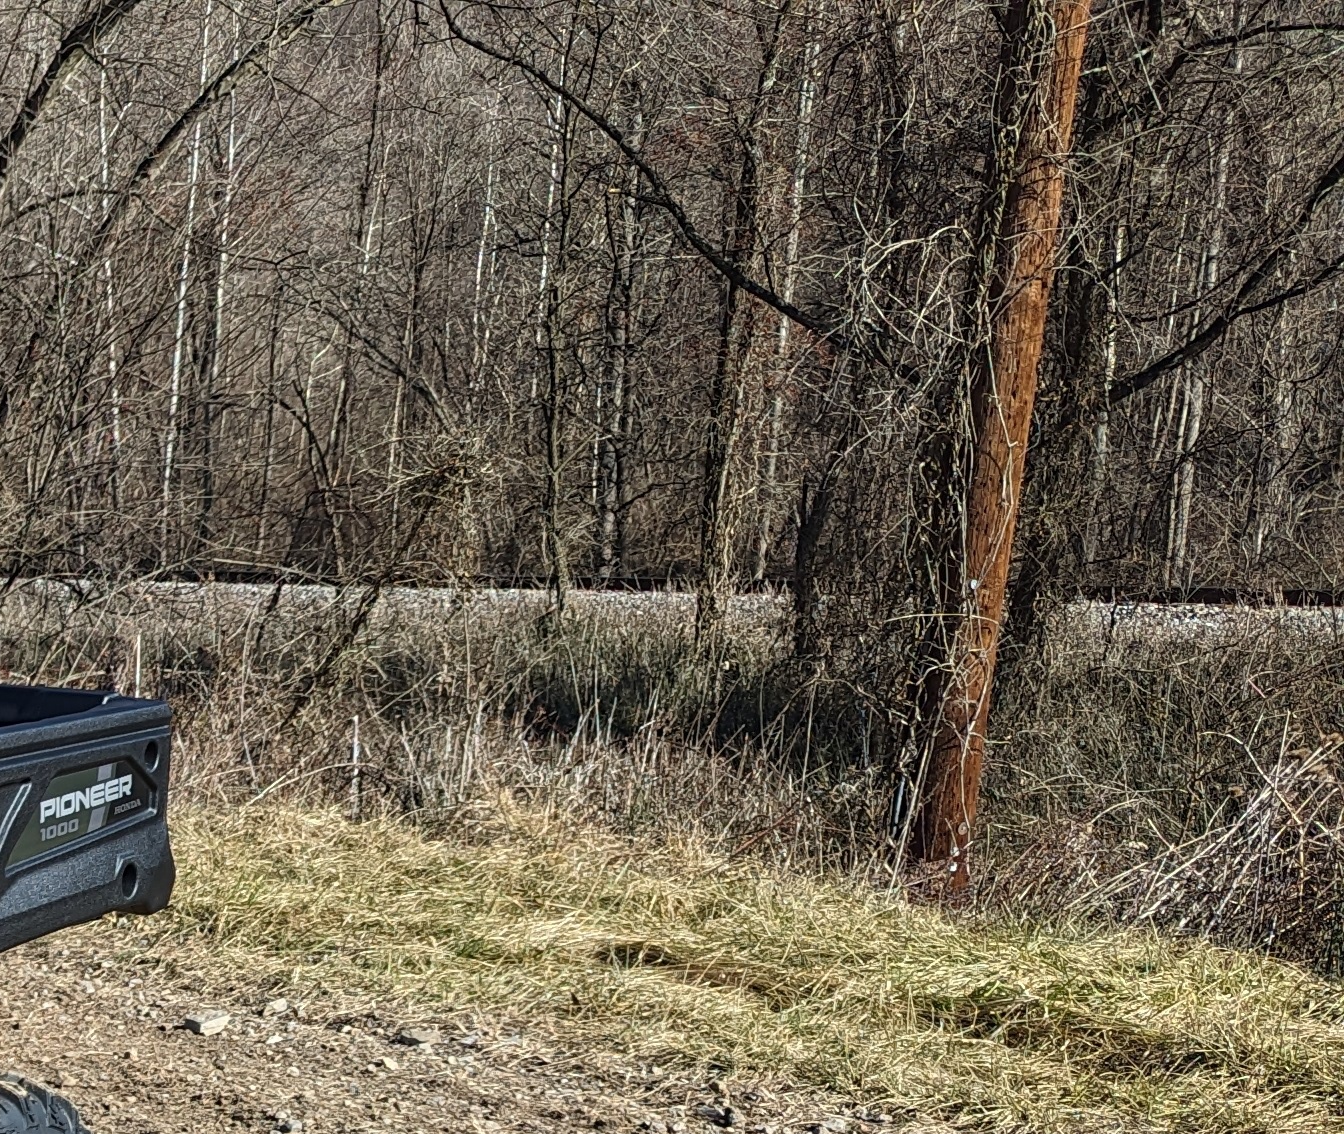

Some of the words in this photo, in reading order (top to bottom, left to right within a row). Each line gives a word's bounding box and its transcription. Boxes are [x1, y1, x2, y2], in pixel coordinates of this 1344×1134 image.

[39, 773, 133, 824] PIONEER
[116, 800, 142, 815] HONDA
[40, 818, 79, 842] 1000
